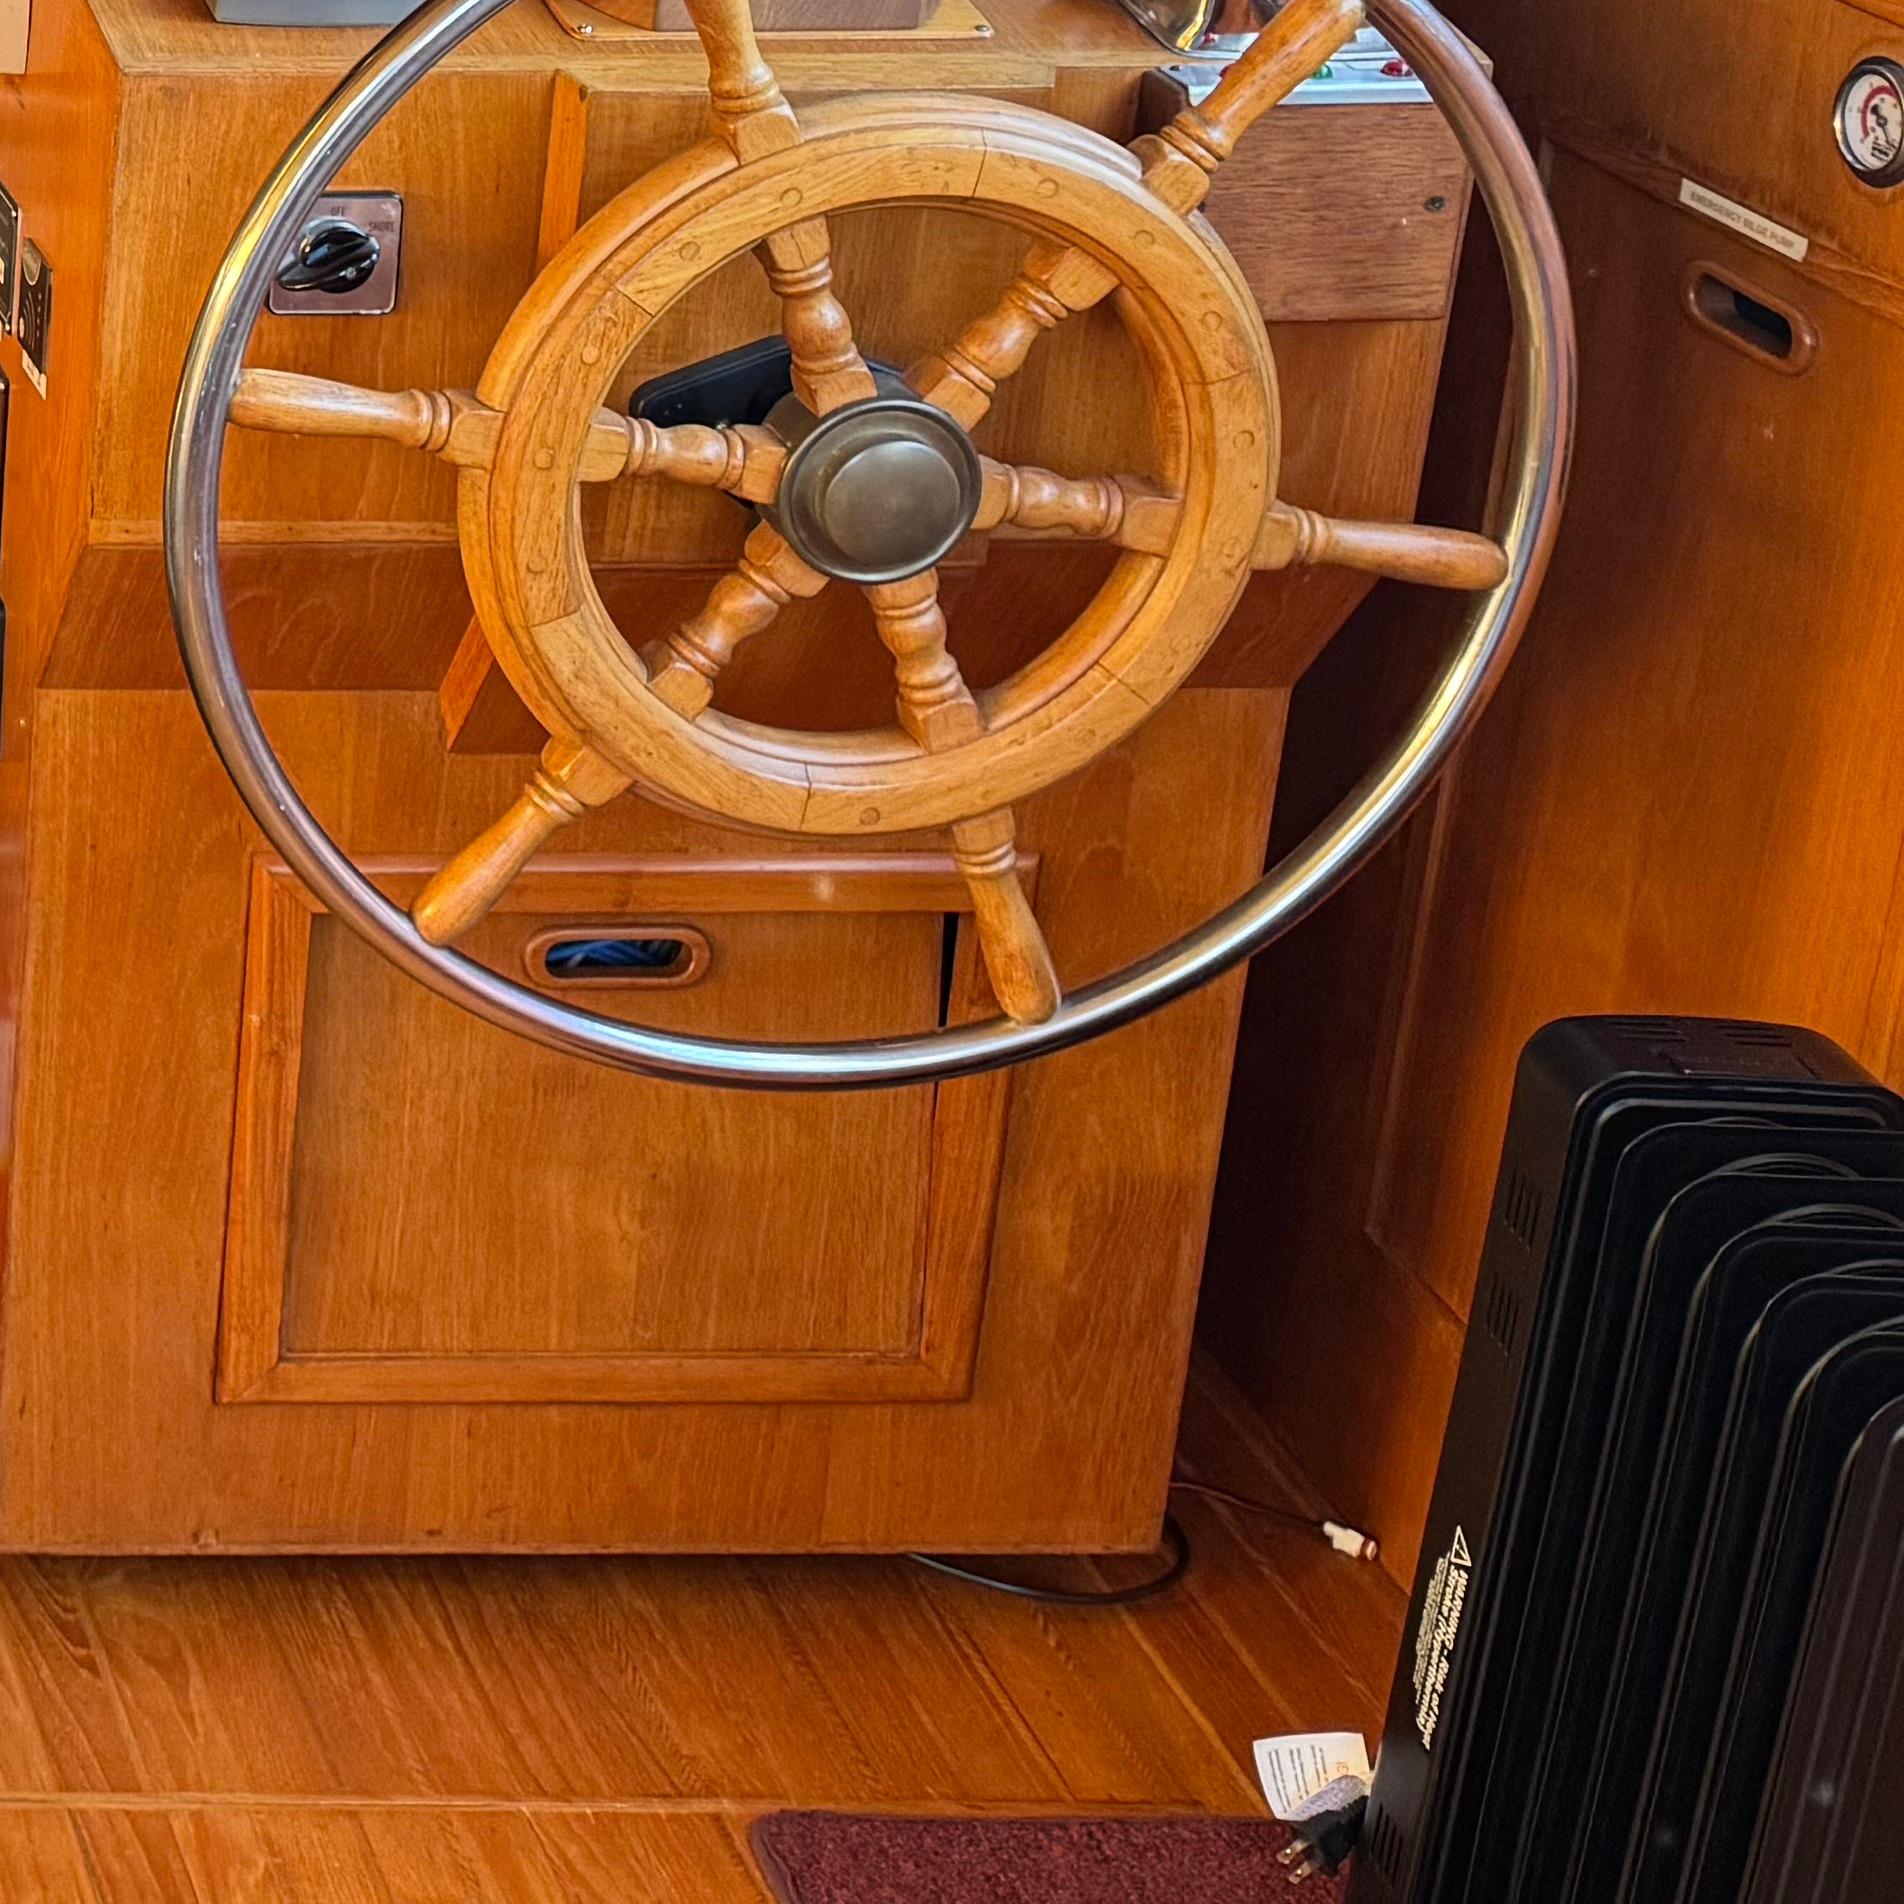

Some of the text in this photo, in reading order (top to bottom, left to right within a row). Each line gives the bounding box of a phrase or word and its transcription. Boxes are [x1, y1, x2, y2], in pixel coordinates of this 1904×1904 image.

[1441, 1564, 1460, 1617] Stroke
[1442, 1568, 1469, 1652] WARNING
[1434, 1656, 1450, 1694] Risk
[1430, 1691, 1441, 1718] of
